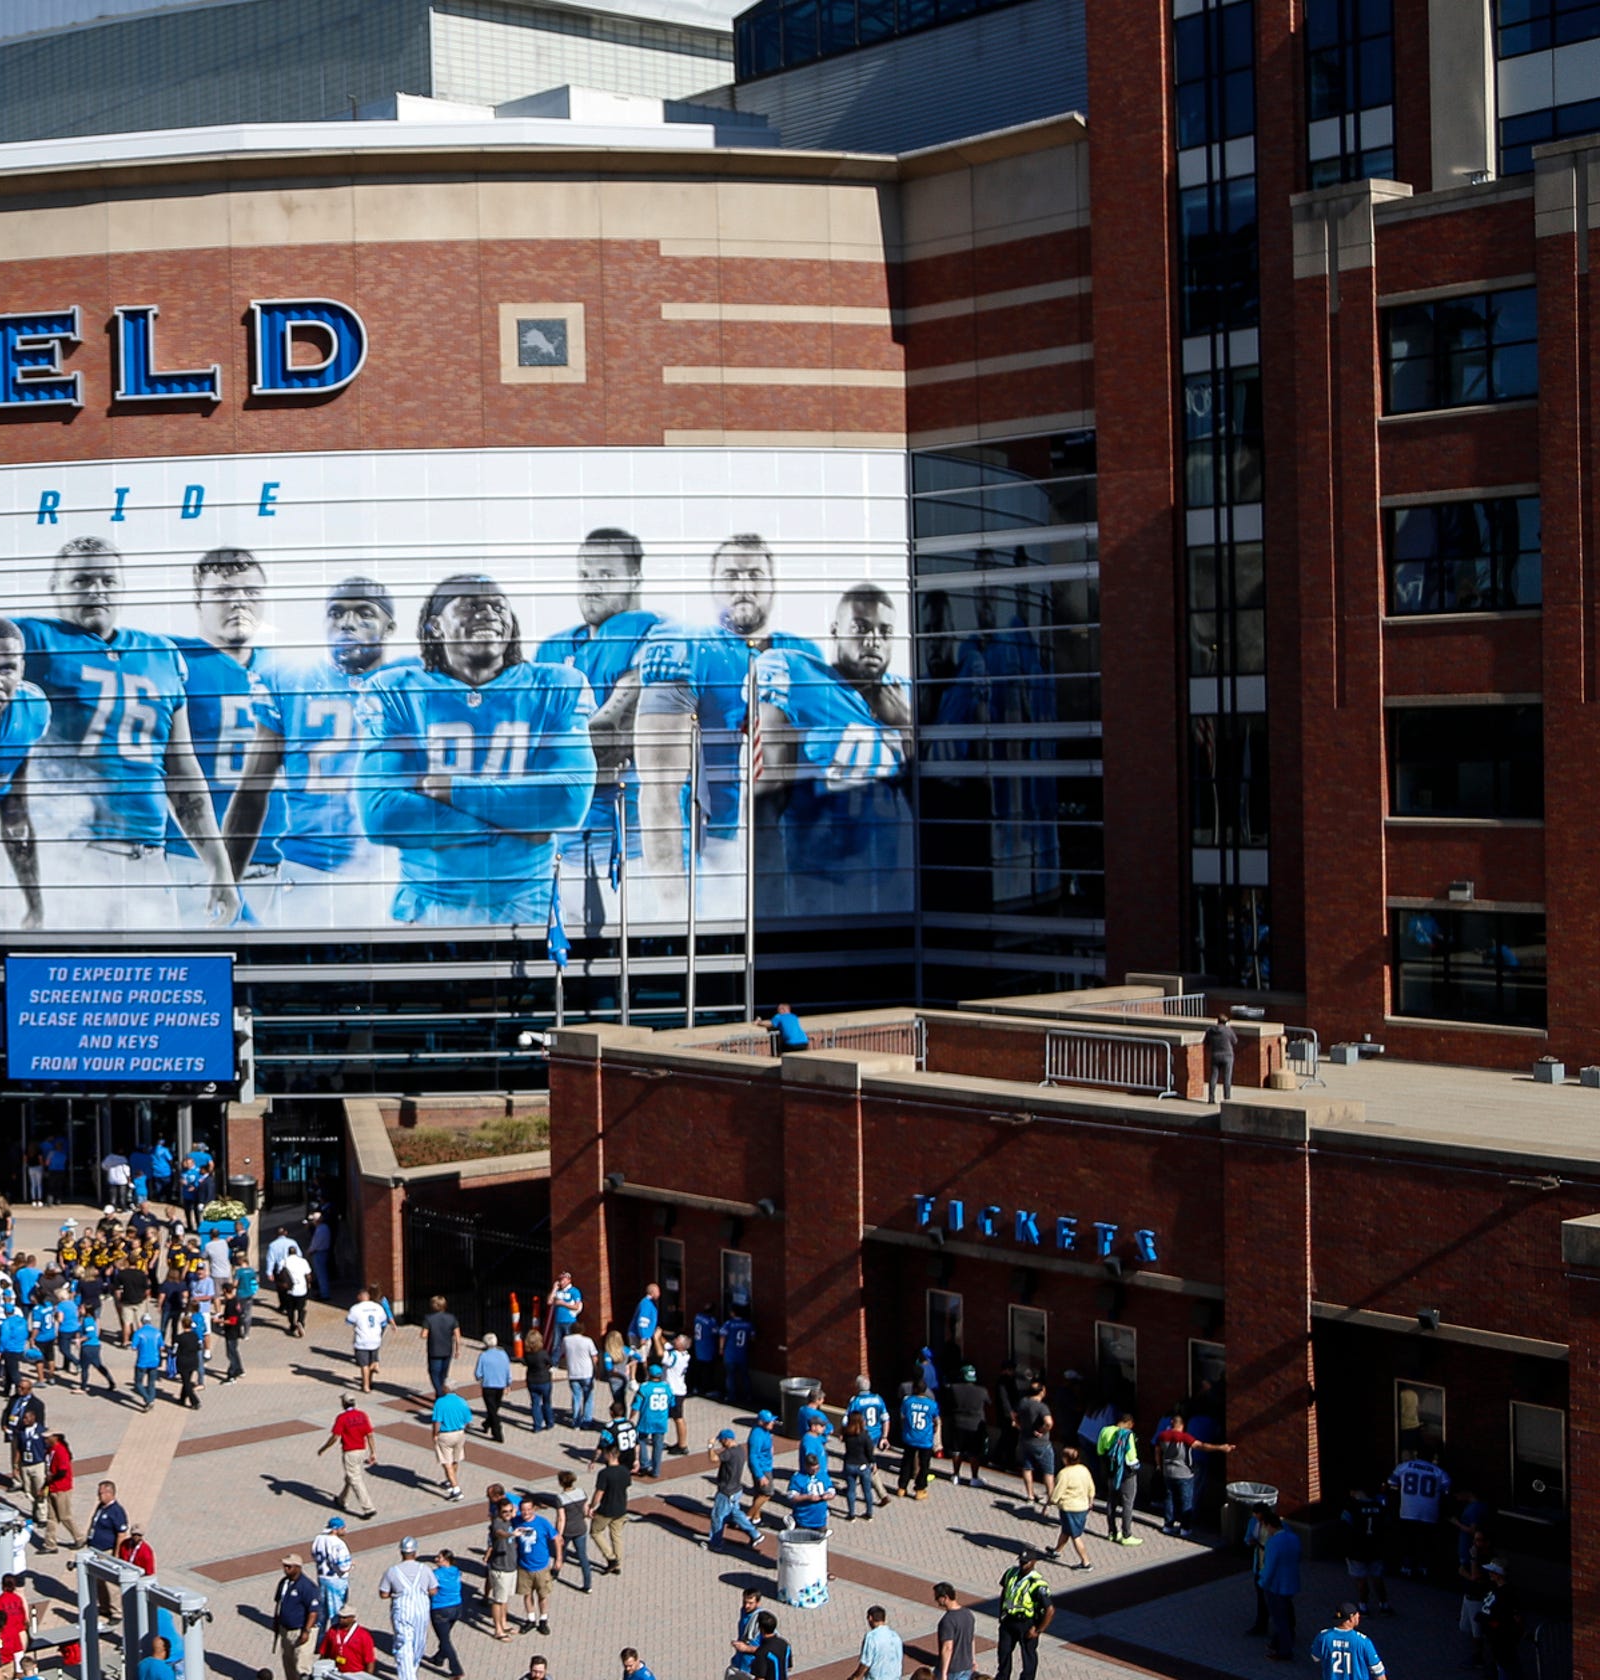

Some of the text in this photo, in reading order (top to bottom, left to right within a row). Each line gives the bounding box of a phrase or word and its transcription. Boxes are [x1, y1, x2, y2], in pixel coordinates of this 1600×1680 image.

[78, 663, 162, 762] 76
[215, 695, 260, 785] 6
[47, 966, 188, 983] TO EXPEDITE THE
[28, 988, 208, 1006] SCREENING PROCESS,
[18, 1011, 222, 1028] PLEASE REMOVE PHONES
[78, 1034, 160, 1050] AND KEYS
[30, 1056, 205, 1072] FROM YOUR POCKETS
[912, 1193, 1158, 1262] TICKETS
[649, 1393, 668, 1411] 68
[866, 1406, 877, 1427] 9
[911, 1411, 927, 1429] 15
[617, 1429, 637, 1450] 68
[1402, 1472, 1439, 1498] 80
[1331, 1650, 1352, 1674] 21
